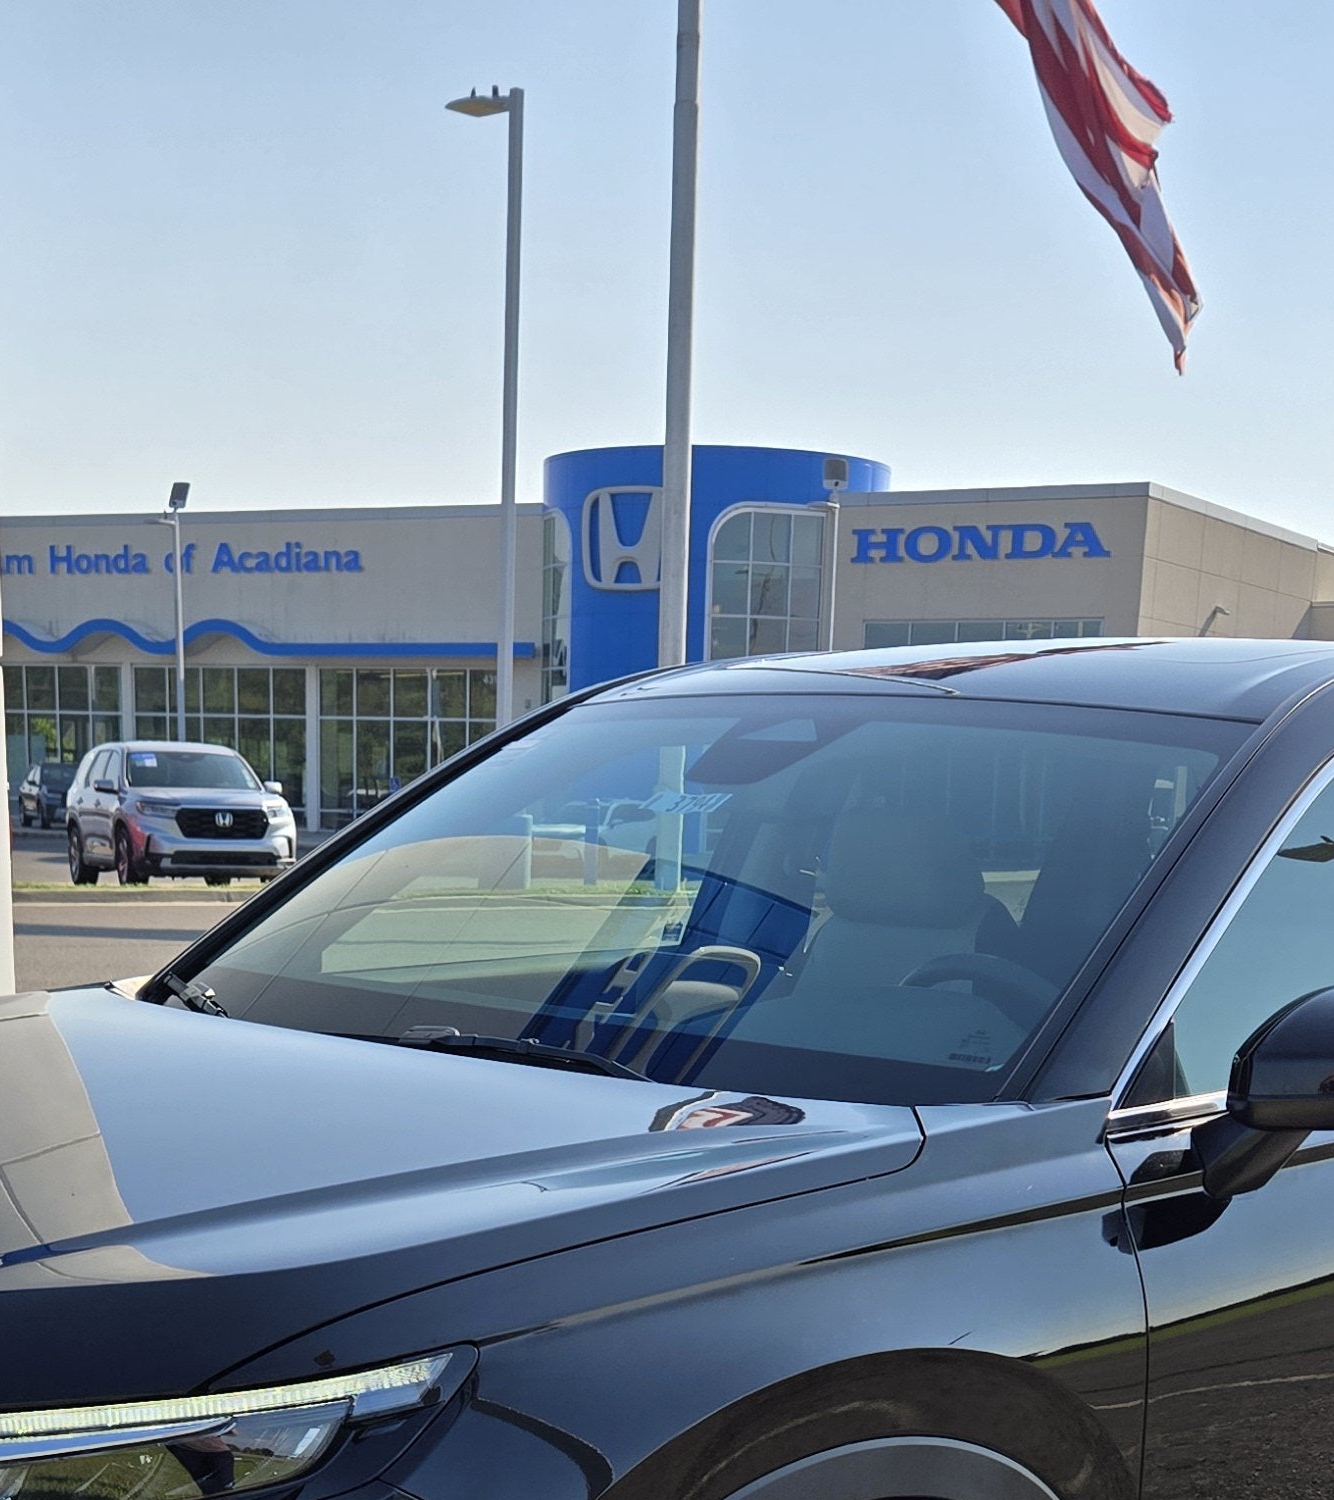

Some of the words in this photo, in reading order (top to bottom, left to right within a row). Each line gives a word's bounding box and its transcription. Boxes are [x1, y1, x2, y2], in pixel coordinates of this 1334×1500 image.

[48, 544, 148, 575] Honda
[211, 541, 363, 574] Acadiana
[850, 521, 1111, 564] HONDA
